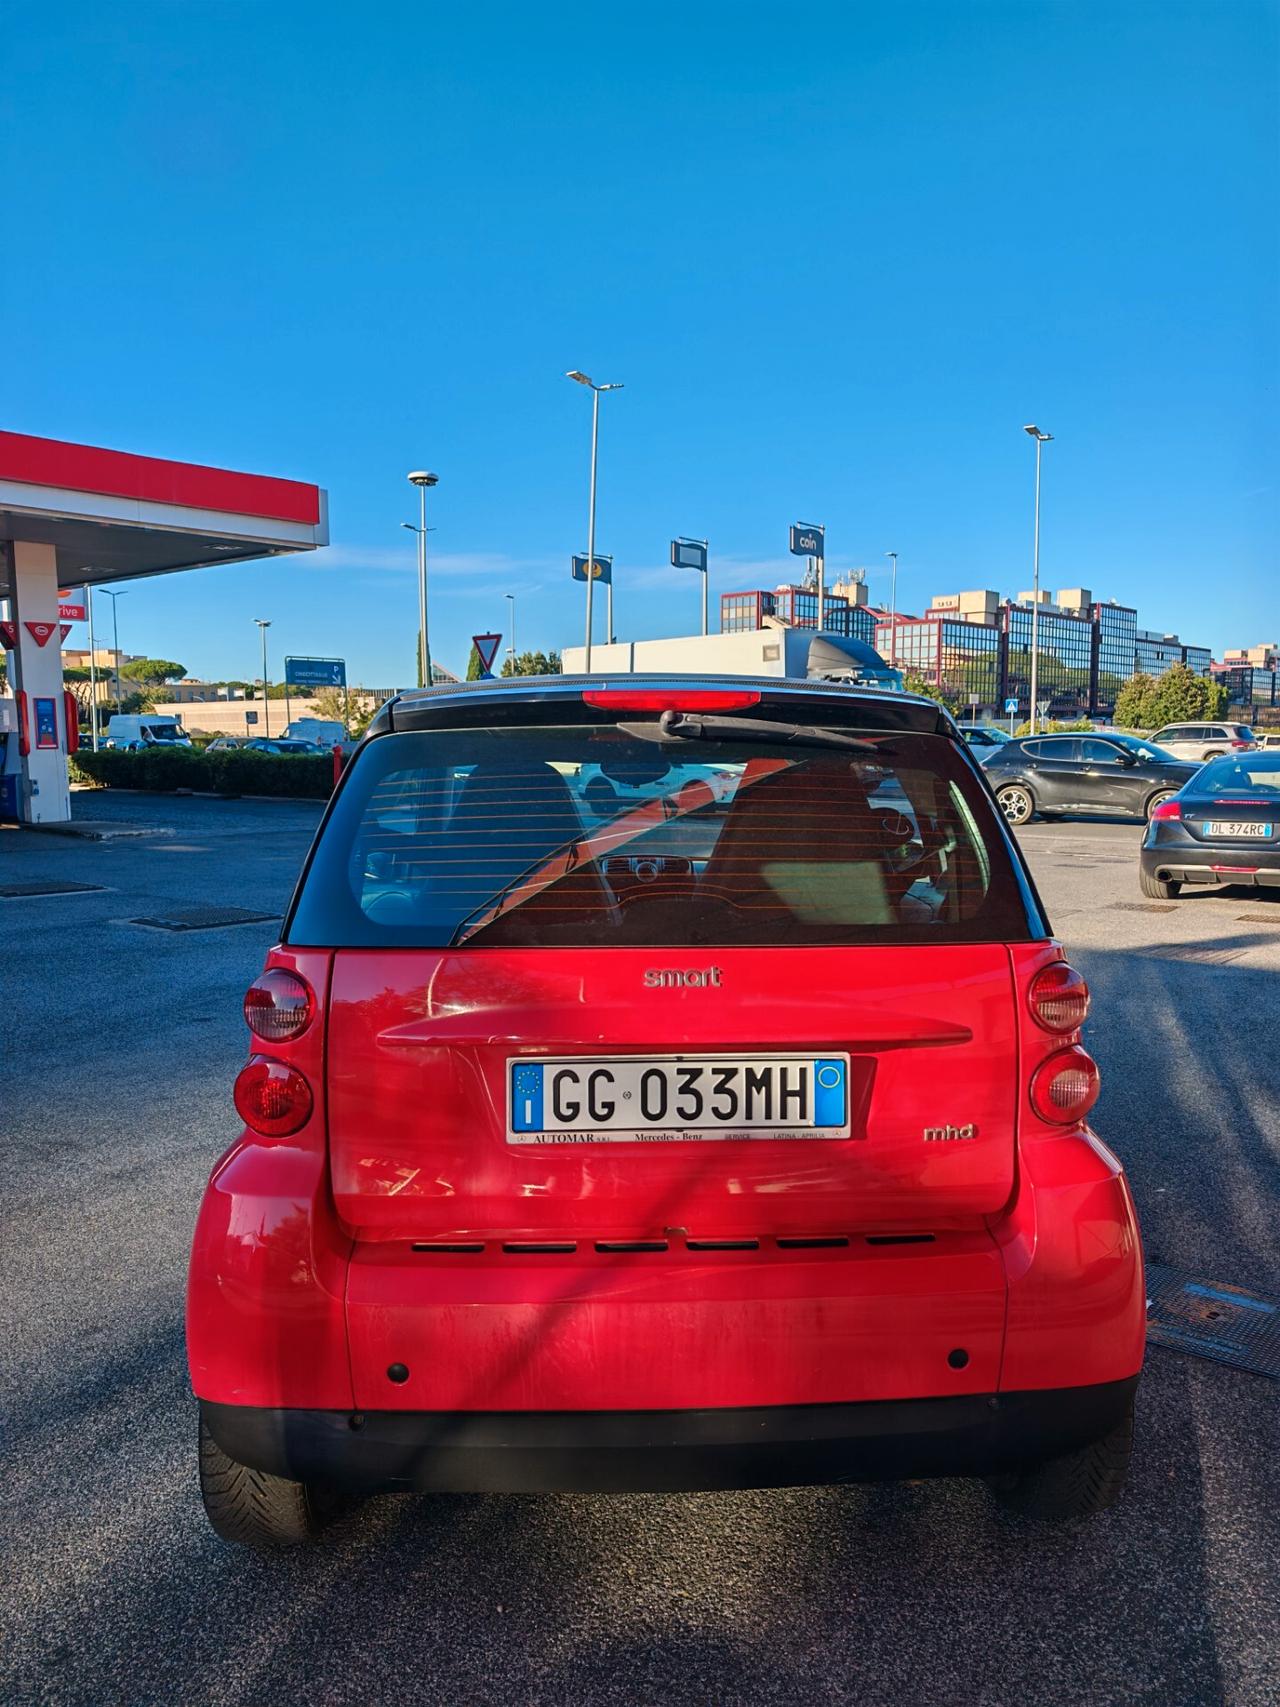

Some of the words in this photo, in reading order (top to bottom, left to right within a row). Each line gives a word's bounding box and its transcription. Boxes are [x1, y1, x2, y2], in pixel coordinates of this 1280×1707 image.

[799, 533, 817, 550] coin
[8, 625, 14, 633] 5
[1211, 823, 1225, 834] DL
[1229, 823, 1265, 836] 374RC
[643, 966, 723, 988] smart
[552, 1068, 616, 1123] GG
[640, 1067, 808, 1122] 033MH
[533, 1133, 594, 1144] AUTOMAR
[923, 1123, 973, 1141] mhd
